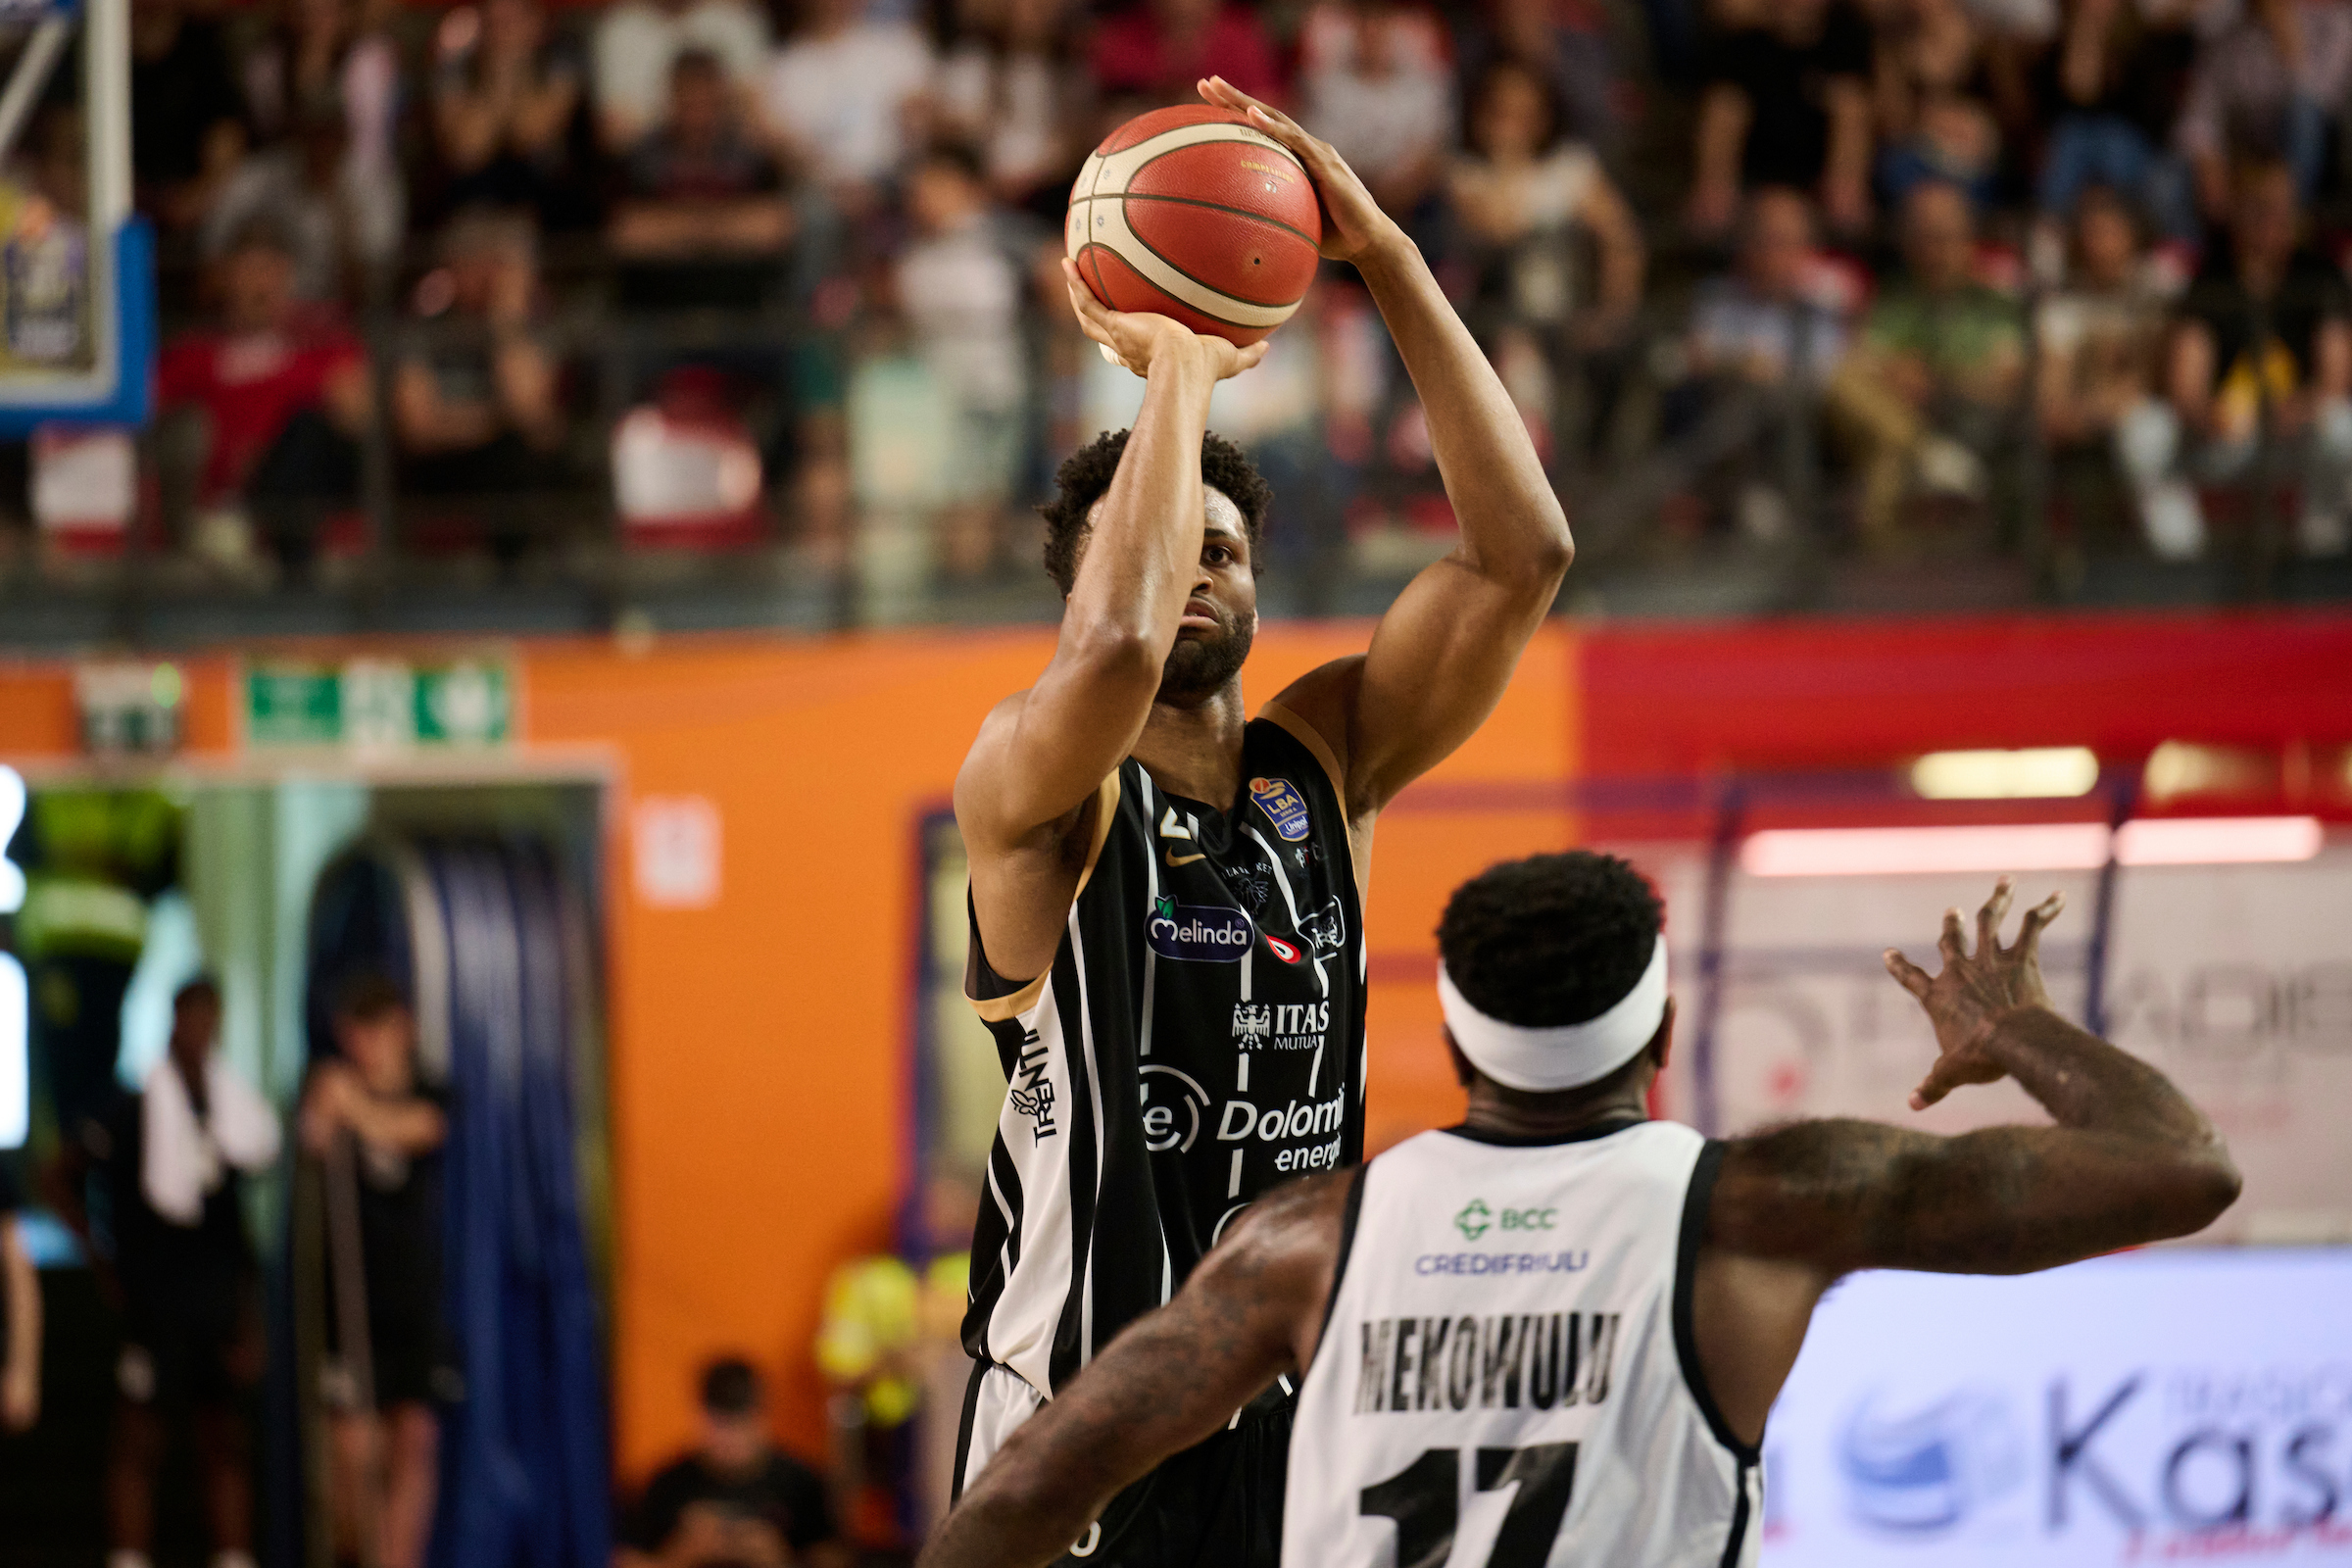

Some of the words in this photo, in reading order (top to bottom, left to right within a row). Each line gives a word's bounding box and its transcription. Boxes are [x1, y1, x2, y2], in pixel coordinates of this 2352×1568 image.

[1266, 794, 1298, 814] LBA
[1151, 917, 1248, 946] Melinda
[1275, 1000, 1330, 1035] ITAS
[1274, 1034, 1318, 1051] MUTUA
[1499, 1208, 1559, 1231] BCC
[1414, 1250, 1590, 1277] CREDIFRIULI
[1359, 1442, 1581, 1568] 17
